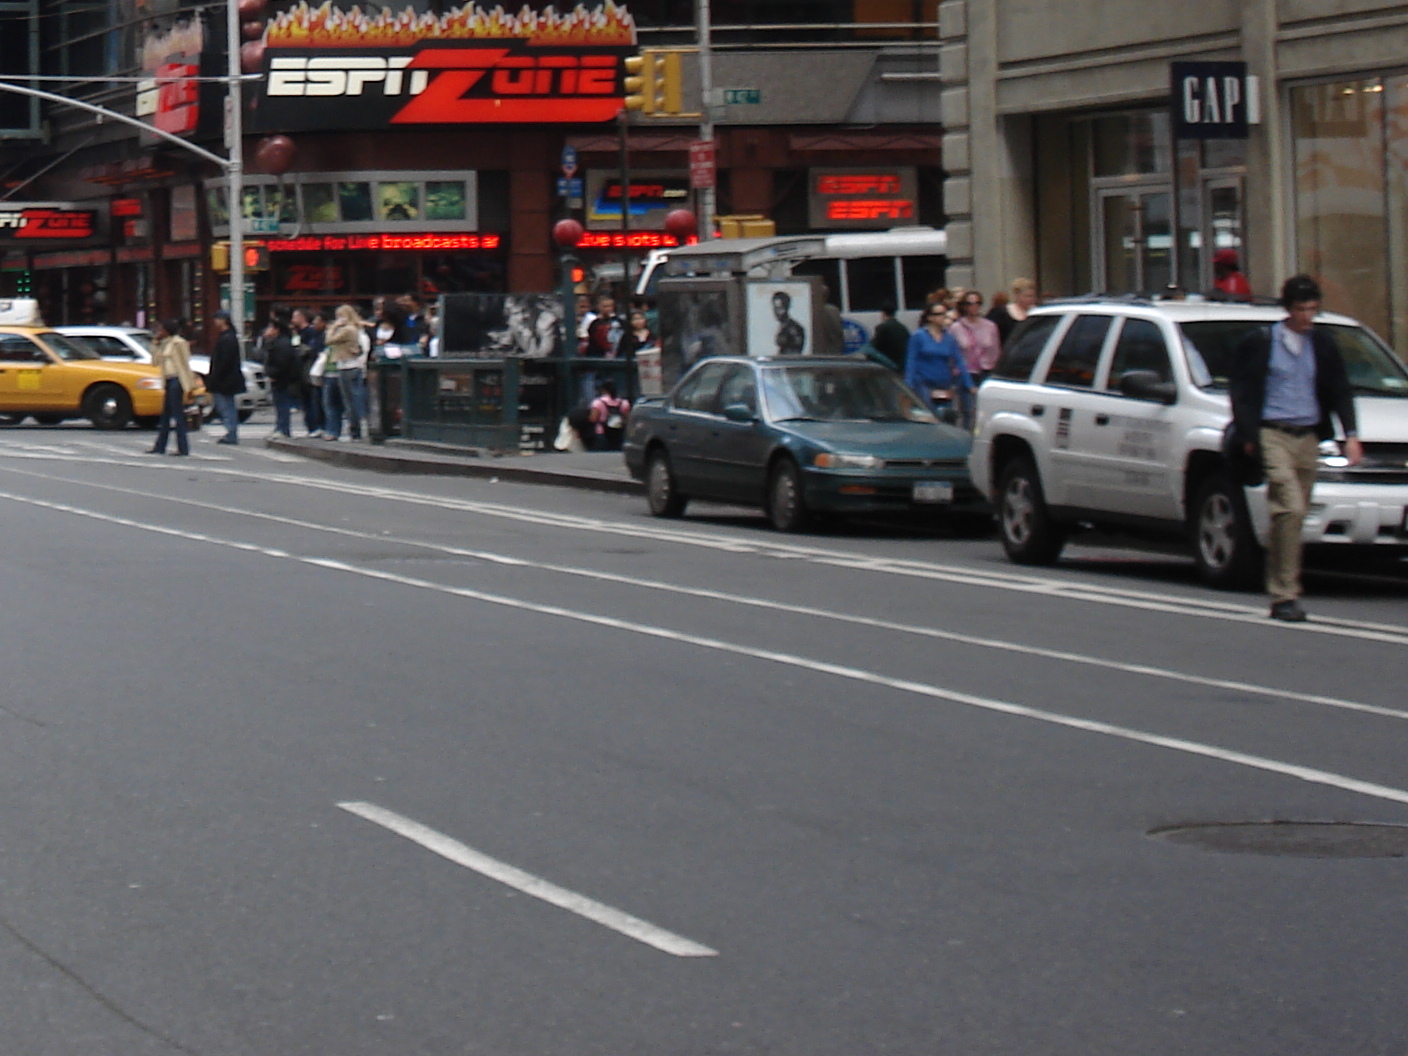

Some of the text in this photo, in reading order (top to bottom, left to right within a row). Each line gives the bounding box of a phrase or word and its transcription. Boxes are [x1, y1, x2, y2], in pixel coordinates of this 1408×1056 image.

[267, 57, 429, 96] ESPN
[1183, 76, 1240, 124] GAP
[818, 175, 900, 194] ESPN
[827, 200, 913, 219] ESPN
[382, 233, 480, 249] broadcasts
